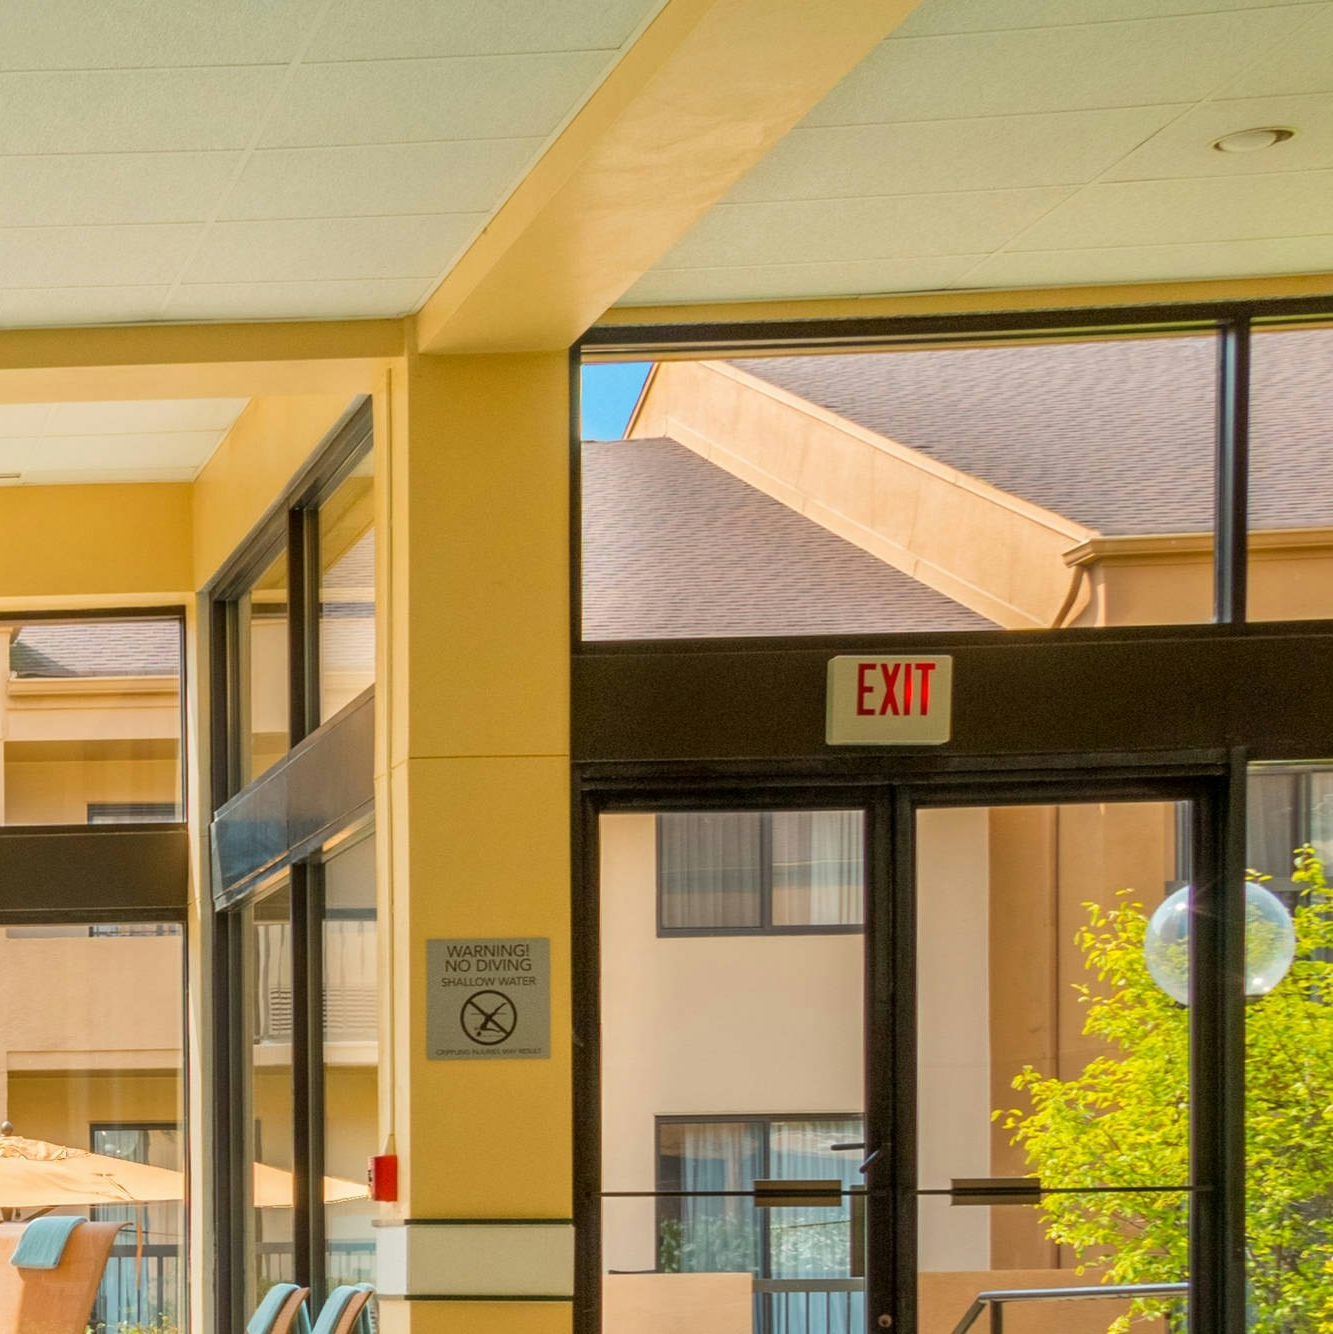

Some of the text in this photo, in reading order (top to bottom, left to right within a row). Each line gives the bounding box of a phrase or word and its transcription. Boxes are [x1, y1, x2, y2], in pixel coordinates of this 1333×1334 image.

[857, 663, 936, 716] EXIT
[447, 944, 530, 958] WARNING!
[445, 958, 532, 972] NO DIVING
[441, 976, 536, 987] SHALLOW WATER
